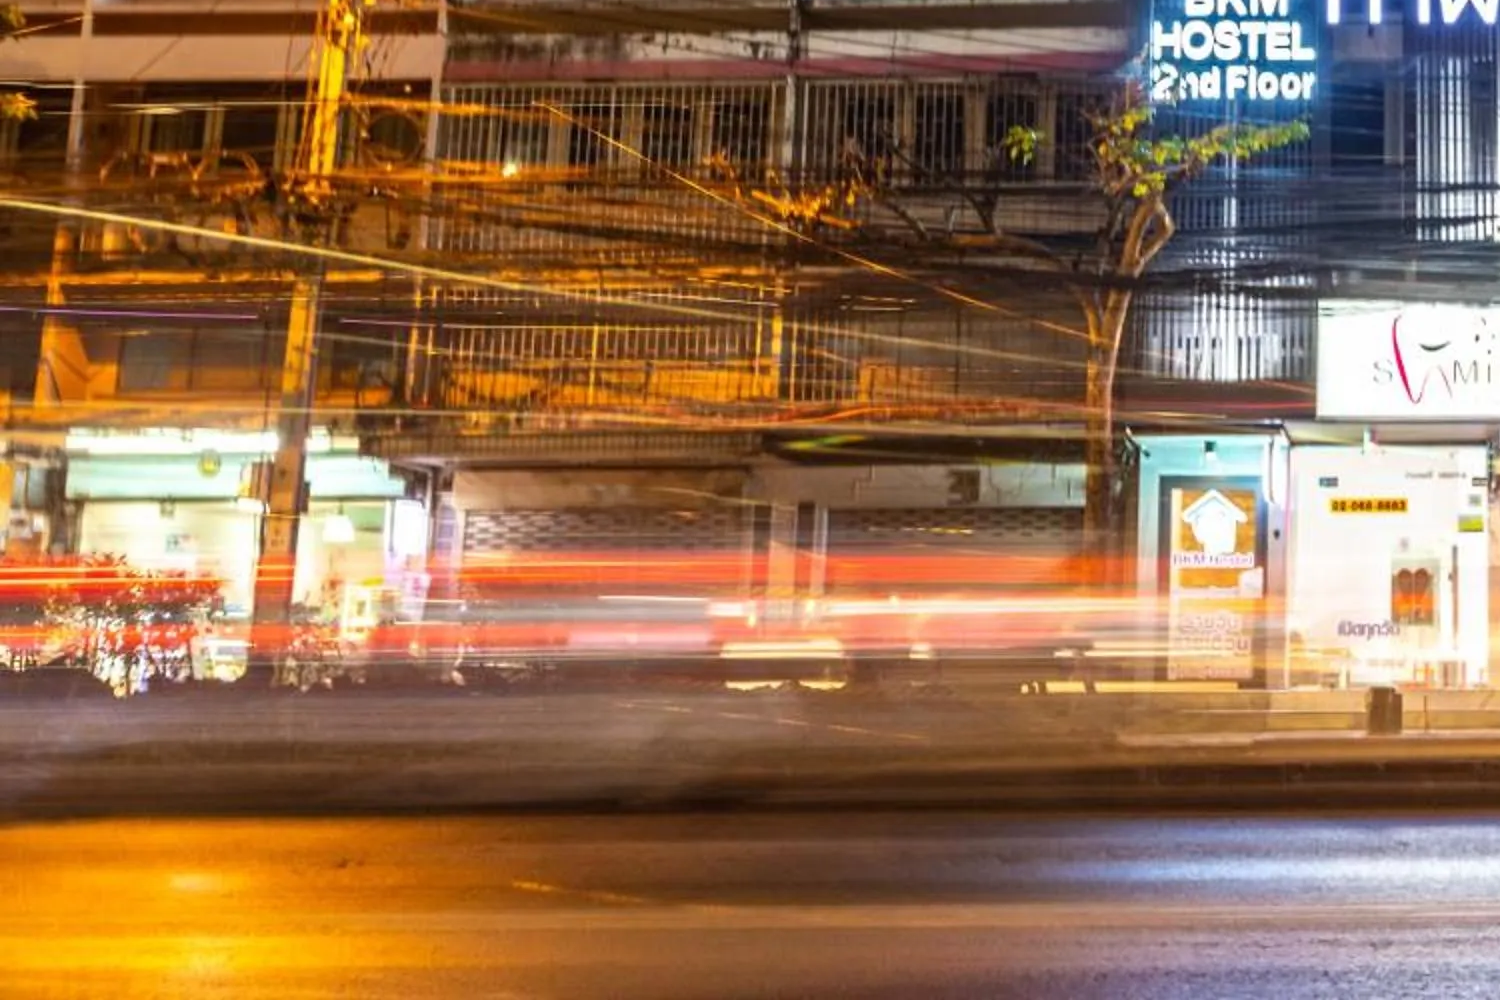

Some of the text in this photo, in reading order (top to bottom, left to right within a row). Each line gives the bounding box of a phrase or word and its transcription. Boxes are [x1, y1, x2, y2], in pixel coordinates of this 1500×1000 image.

[1153, 19, 1316, 61] HOSTEL
[1153, 62, 1316, 101] 2nd Floor
